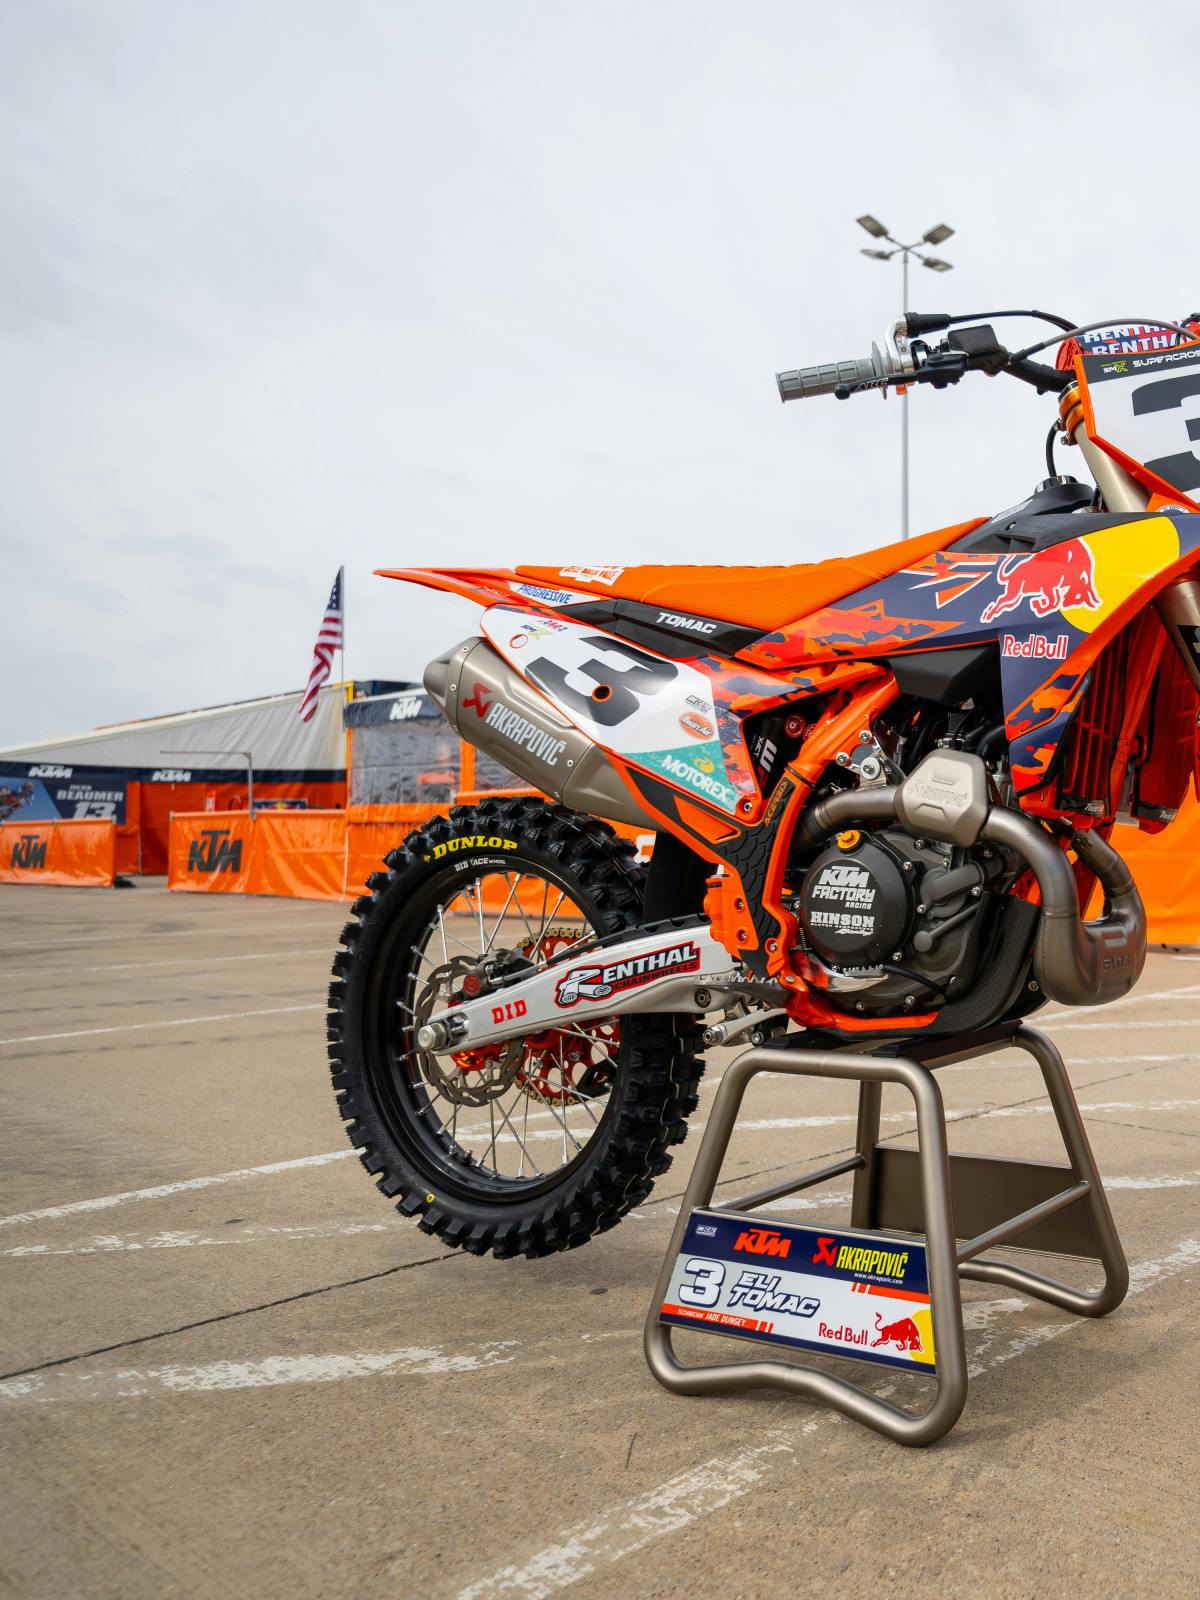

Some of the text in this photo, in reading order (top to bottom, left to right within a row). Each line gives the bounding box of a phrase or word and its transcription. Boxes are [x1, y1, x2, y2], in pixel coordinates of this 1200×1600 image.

[518, 584, 573, 605] PROGRESSIVE
[655, 612, 718, 634] TOMAC
[1002, 634, 1069, 660] Red Bull
[525, 636, 679, 727] 3
[389, 696, 423, 721] KTM
[28, 764, 74, 779] KTM
[151, 769, 193, 782] KTM
[661, 755, 732, 802] MOTOREX
[56, 789, 124, 802] BEAUMER
[73, 802, 118, 820] 13
[10, 834, 47, 868] KTM
[187, 829, 244, 873] KTM
[433, 835, 518, 860] DUNLOP
[818, 865, 870, 888] KTM
[811, 885, 876, 903] FACTORY
[844, 901, 873, 910] RACING
[810, 911, 875, 928] HINSON
[650, 961, 697, 980] WHEELS
[733, 1228, 792, 1259] KTM
[836, 1245, 909, 1278] AKRAPOVIČ
[678, 1257, 726, 1308] 3
[736, 1271, 782, 1292] ELI
[727, 1286, 820, 1318] TOMAC
[677, 1309, 748, 1327] TECHNICIAN JADE DUNGEY
[818, 1322, 869, 1345] Red Bull
